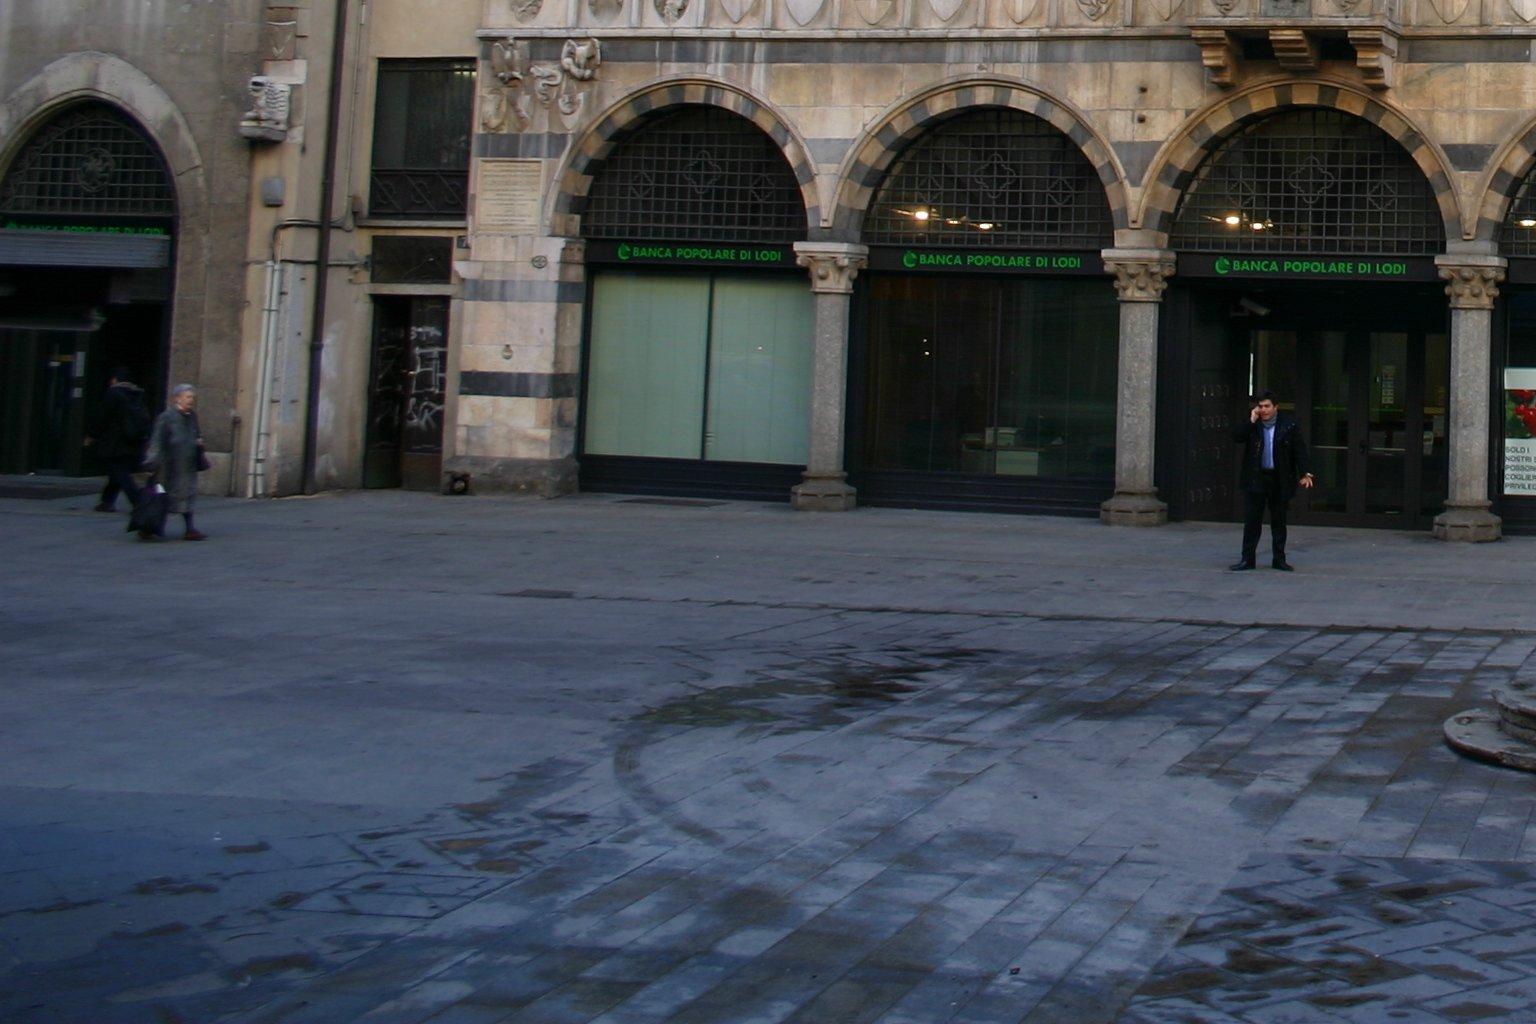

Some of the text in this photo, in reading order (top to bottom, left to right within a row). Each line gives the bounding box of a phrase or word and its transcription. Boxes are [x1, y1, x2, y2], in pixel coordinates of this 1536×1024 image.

[632, 246, 782, 262] BANCA POPOLARE DI LODI
[918, 253, 1081, 269] BANCA POPOLARE DI LODI
[1232, 260, 1406, 275] BANCA POPOLARE DI LODI
[1505, 446, 1526, 454] SOLO
[1505, 455, 1532, 463] NOSTRI
